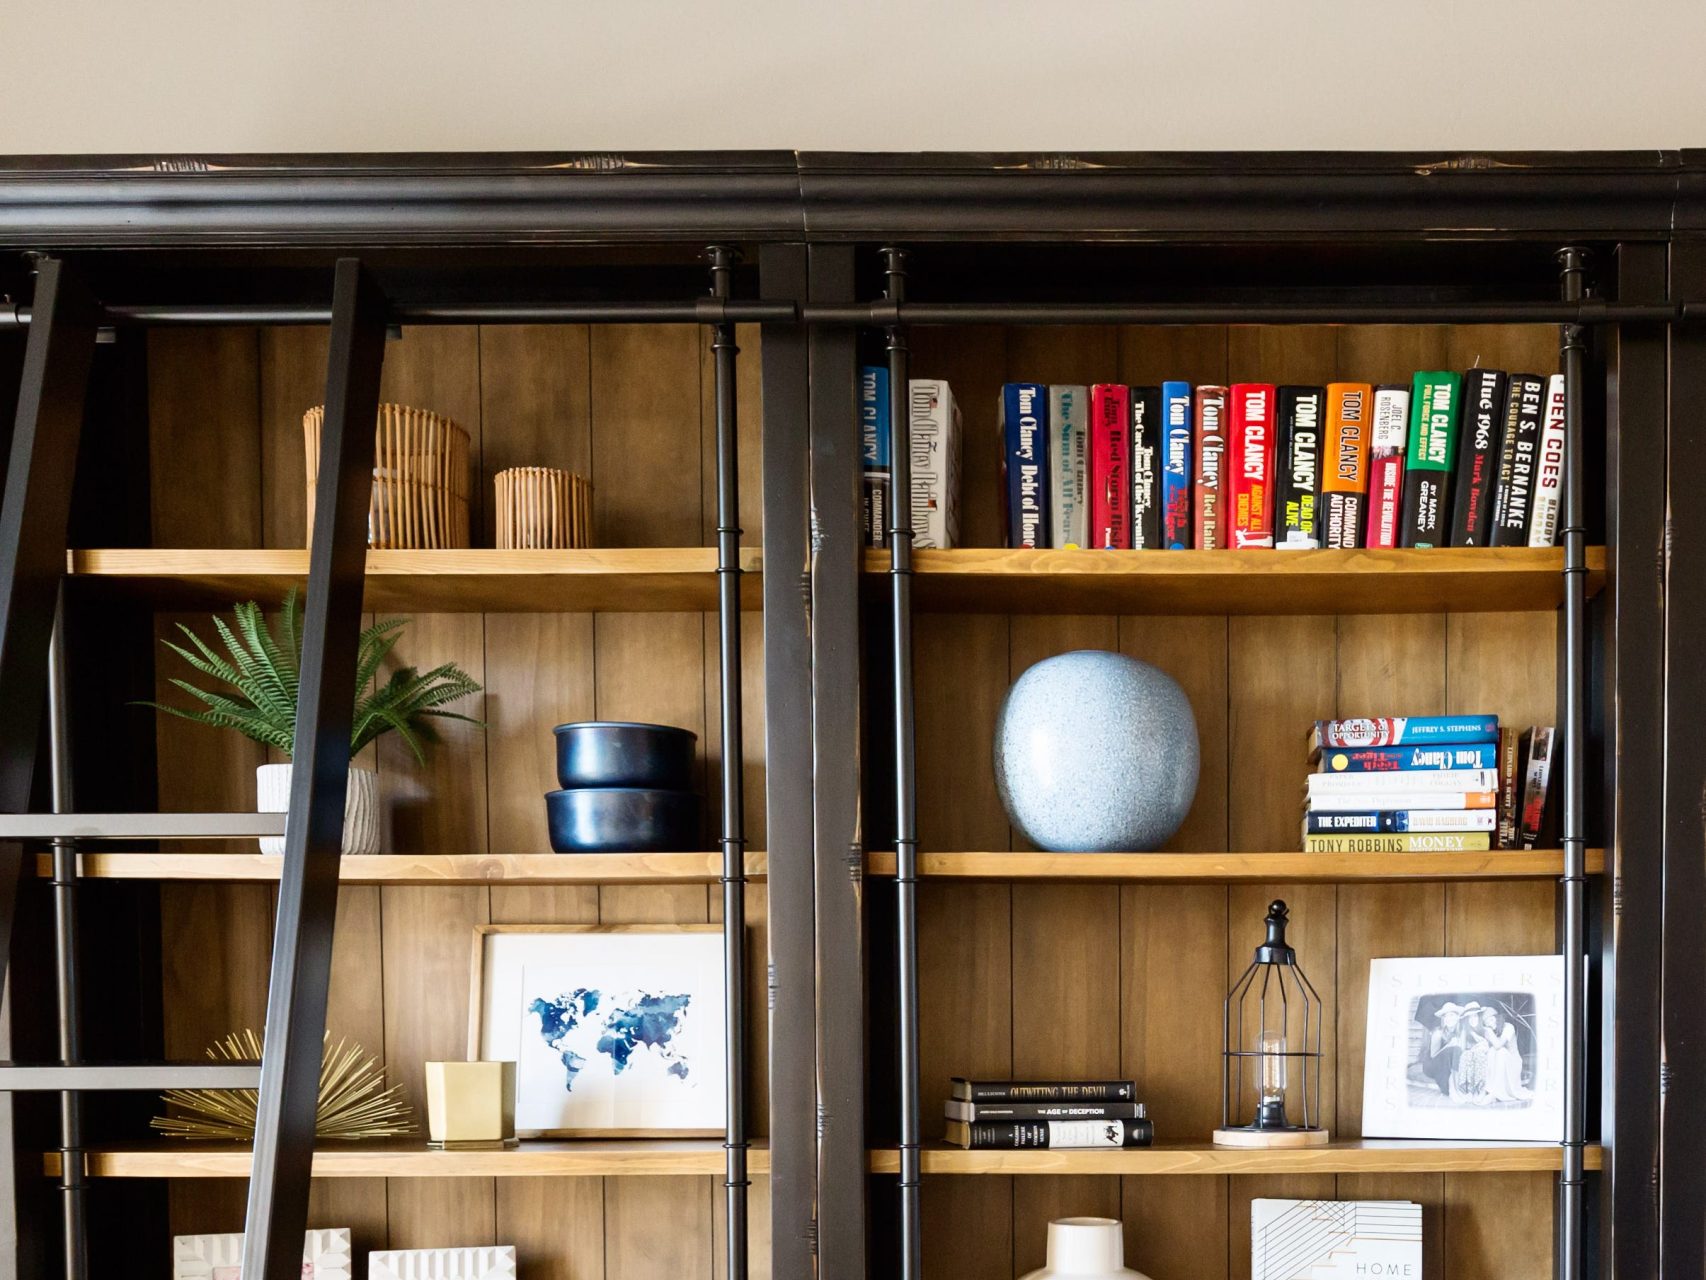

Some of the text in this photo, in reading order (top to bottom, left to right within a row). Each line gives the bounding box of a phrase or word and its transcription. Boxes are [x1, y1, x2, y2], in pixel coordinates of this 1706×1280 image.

[912, 385, 939, 417] Tom
[1390, 404, 1402, 423] JOEL
[1511, 381, 1522, 399] THE
[1165, 396, 1189, 475] Tom Clancy
[1244, 391, 1265, 480] TOM CLANCY
[1338, 392, 1362, 481] TOM CLANCY
[1378, 396, 1392, 440] ROSENBERG
[1418, 384, 1432, 461] FULL FORCE AND EFFECT
[1428, 383, 1451, 464] TOM CLANCY
[1505, 402, 1520, 445] COURAGE
[1542, 393, 1564, 489] BEN COES
[911, 419, 939, 468] Clancy
[1292, 395, 1317, 491] TOM CLANCY
[1466, 372, 1497, 532] Hué 1968 Mark Bowden
[1504, 449, 1514, 460] TO
[1506, 382, 1541, 529] BEN S. BERNANKE
[1016, 388, 1039, 550] Tom Clancy Debt of Hono
[1061, 391, 1074, 544] The Sum of All Fears
[1134, 401, 1145, 550] The Cardinal of the Kremlin
[1141, 446, 1153, 508] Tom Clancy
[1197, 396, 1224, 550] Tom Clancy Red Rabb
[1501, 463, 1512, 481] ACT
[872, 489, 882, 541] COMMANDER
[911, 472, 938, 535] Rainbow
[1237, 494, 1249, 527] ENEMIES
[1250, 484, 1263, 531] AGAINST ALL
[1285, 502, 1299, 527] ALIVE
[1300, 495, 1313, 533] DEAD OR
[1328, 494, 1343, 550] AUTHORITY
[1343, 497, 1356, 549] COMMAND
[1380, 462, 1397, 545] INSIDE THE REVOLUTION
[1417, 481, 1429, 532] GREANEY
[1426, 485, 1437, 530] BY MARK
[1543, 498, 1557, 545] BLOODY
[1332, 731, 1390, 740] OPPORTUNITY
[1333, 723, 1377, 732] TARGETS
[1412, 726, 1438, 734] JEFFREY
[1446, 724, 1481, 732] STEPHENS
[1410, 748, 1483, 769] Tom Clancy
[1311, 836, 1465, 852] TONY ROBBINS MONEY
[1318, 816, 1377, 827] THE EXPEDITER
[1391, 973, 1561, 987] SISTERS
[1010, 1086, 1106, 1098] OUTWITTING THE DEVIL
[1356, 1263, 1412, 1276] HOME
